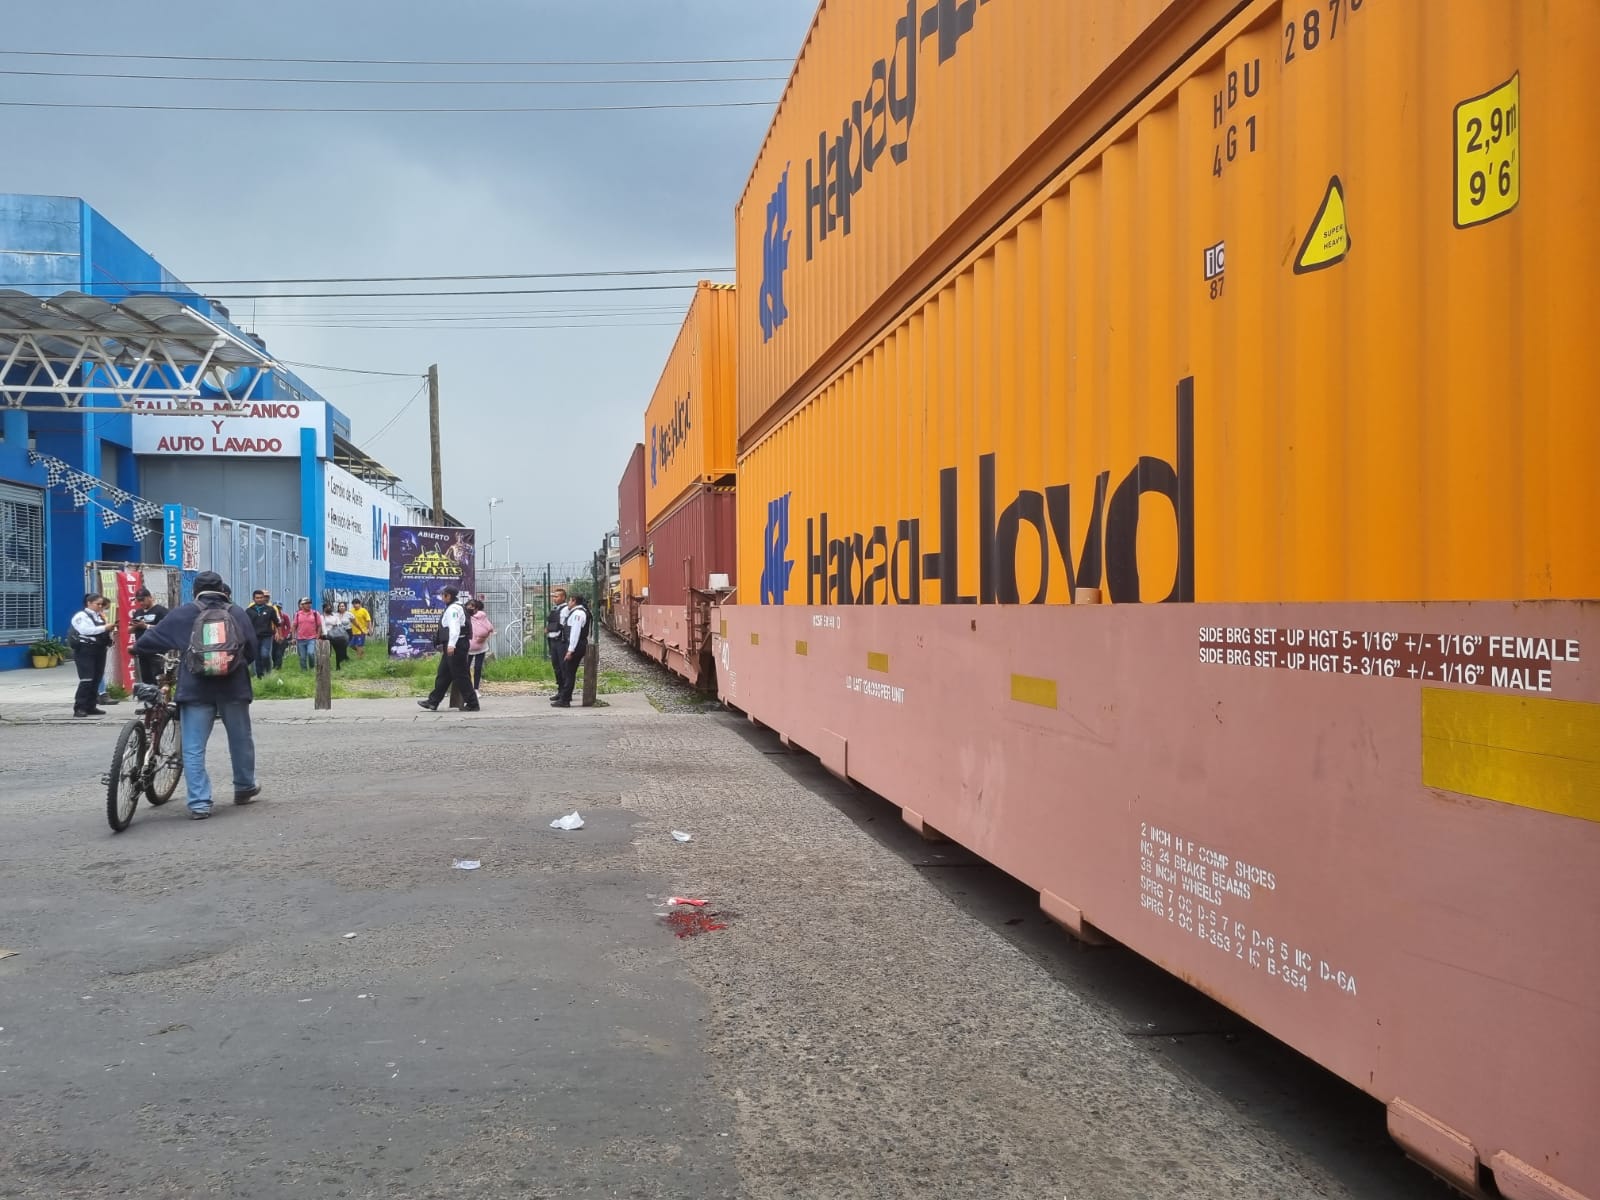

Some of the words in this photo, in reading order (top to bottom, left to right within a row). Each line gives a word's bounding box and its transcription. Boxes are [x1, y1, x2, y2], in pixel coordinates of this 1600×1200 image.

[1323, 223, 1344, 239] SUPER
[157, 436, 205, 452] AUTO
[212, 437, 283, 452] LAVADO
[211, 420, 225, 434] Y
[169, 510, 177, 561] 1155
[417, 531, 450, 541] ABIERTO
[402, 567, 463, 576] GALAXIAS
[1199, 627, 1224, 643] SIDE
[1226, 628, 1250, 645] BRG
[1254, 629, 1277, 645] SET
[1308, 629, 1339, 648] HGT
[1489, 636, 1580, 663] FEMALE
[1199, 647, 1224, 664] SIDE
[1226, 649, 1250, 666] BRG
[1254, 651, 1277, 667] SET
[1308, 653, 1339, 673] HGT
[1491, 665, 1552, 693] MALE
[1141, 822, 1147, 837] 2
[1150, 826, 1171, 848] INCH
[1175, 837, 1183, 853] H
[1187, 842, 1194, 856] F
[1198, 847, 1229, 871] COMP
[1235, 860, 1276, 890] SHOES
[1159, 847, 1170, 864] 24
[1174, 854, 1207, 882] BRAKE
[1212, 870, 1251, 900] BEAMS
[1155, 863, 1177, 886] INCH
[1181, 874, 1222, 906] WHEELS
[1140, 875, 1164, 899] SPRG
[1167, 888, 1174, 903] 7
[1221, 916, 1229, 931] 7
[1234, 921, 1246, 941] IC
[1252, 930, 1274, 954] D-6
[1280, 942, 1288, 961] 5
[1320, 960, 1357, 996] D-6A
[1140, 893, 1164, 918] SPRG
[1167, 907, 1175, 923] 2
[1235, 942, 1244, 960] 2
[1267, 957, 1308, 993] B-354
